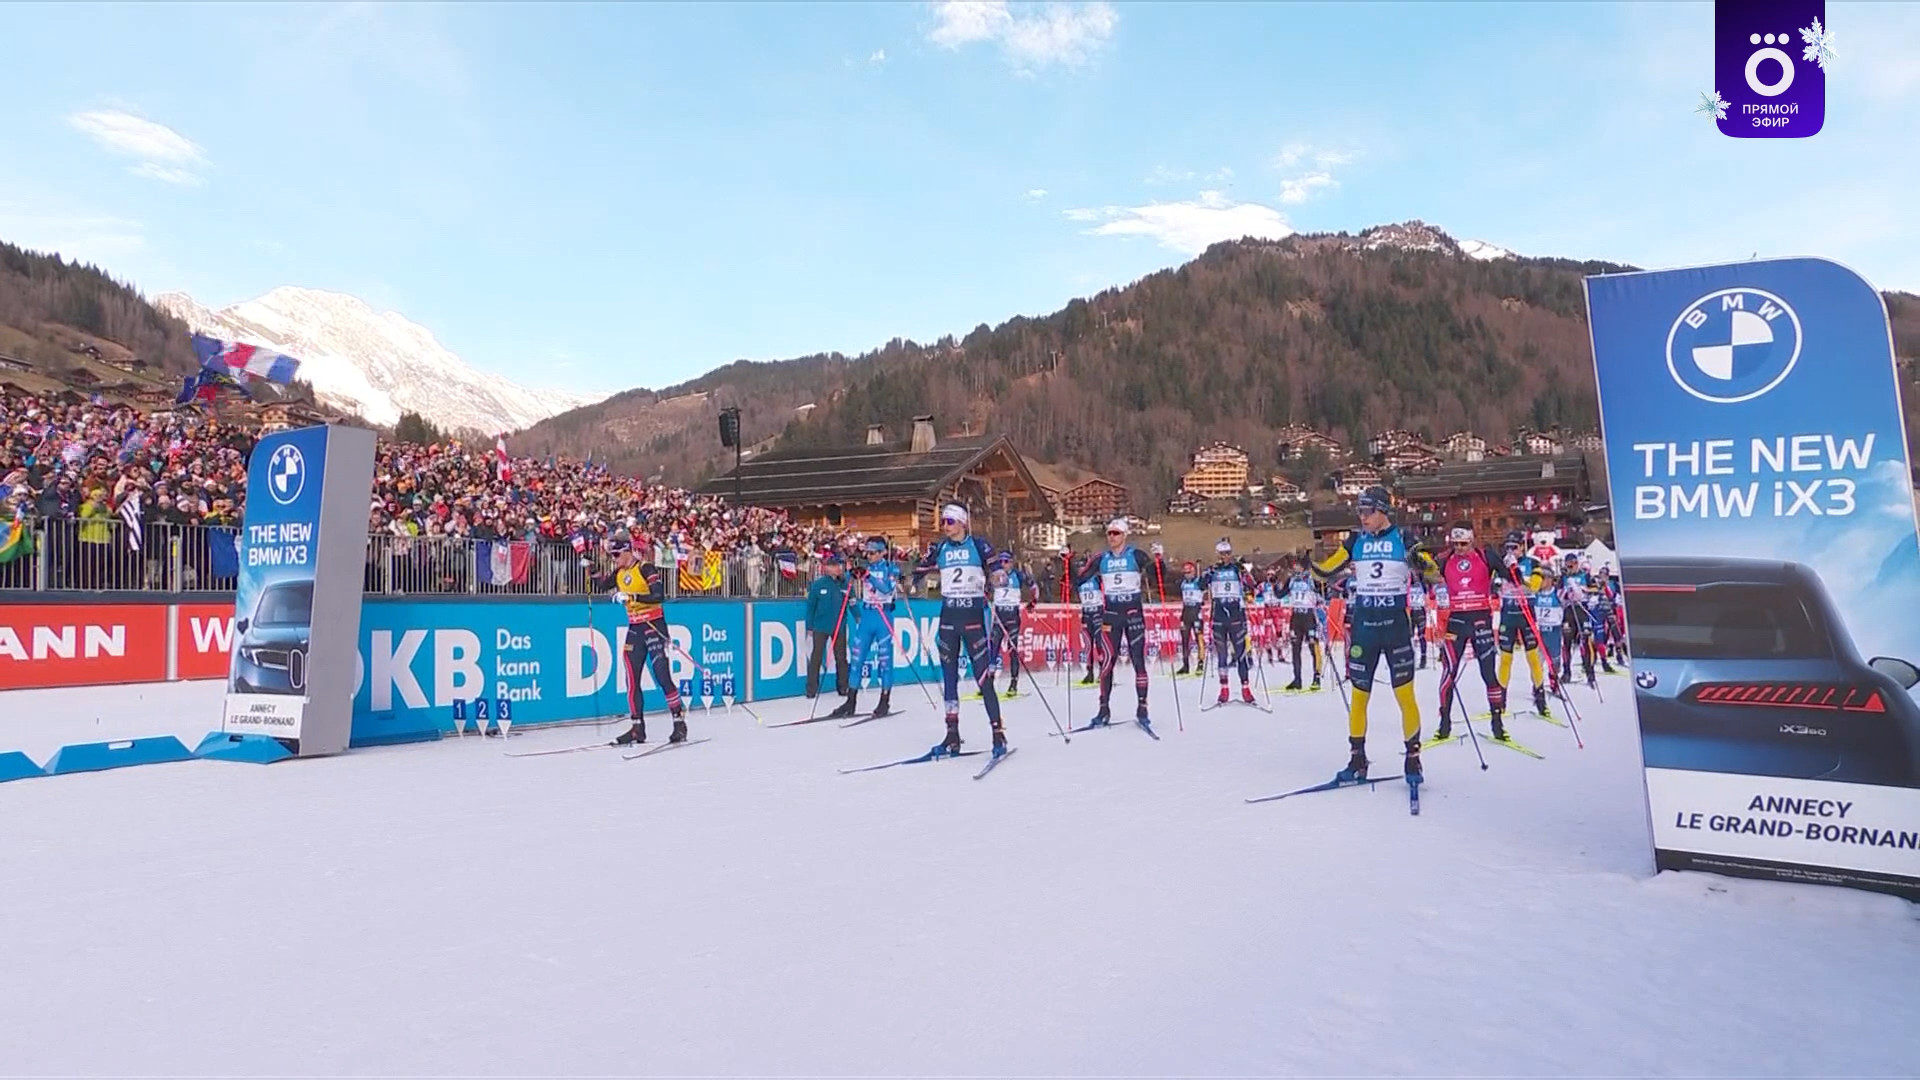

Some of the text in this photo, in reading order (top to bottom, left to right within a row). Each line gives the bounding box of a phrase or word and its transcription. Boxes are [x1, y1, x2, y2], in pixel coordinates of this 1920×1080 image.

[1685, 294, 1783, 329] BMW
[1633, 433, 1876, 477] THE NEW
[1635, 478, 1856, 519] BMW iX3
[249, 522, 312, 544] THE NEW
[945, 549, 970, 560] DKB
[1363, 541, 1393, 553] DKB
[248, 545, 308, 567] BMW iX3
[952, 568, 963, 583] 2
[1113, 573, 1122, 585] 5
[1370, 562, 1384, 579] 3
[1003, 588, 1010, 599] 7
[1224, 581, 1232, 592] 8
[1084, 591, 1094, 600] 10
[496, 628, 532, 650] Das
[702, 623, 728, 642] Das
[702, 645, 733, 664] kann
[496, 654, 540, 676] kann
[861, 665, 869, 677] 8
[496, 679, 542, 702] Bank
[682, 682, 690, 694] 4
[703, 681, 711, 695] 5
[724, 681, 733, 695] 6
[250, 704, 276, 714] ANNECY
[455, 701, 463, 718] 1
[478, 701, 487, 718] 2
[500, 701, 509, 718] 3
[230, 715, 295, 726] LE GRAND-BORNAND
[1748, 795, 1853, 818] ANNECY
[1675, 812, 1920, 850] LE GRAND-BORNAN
